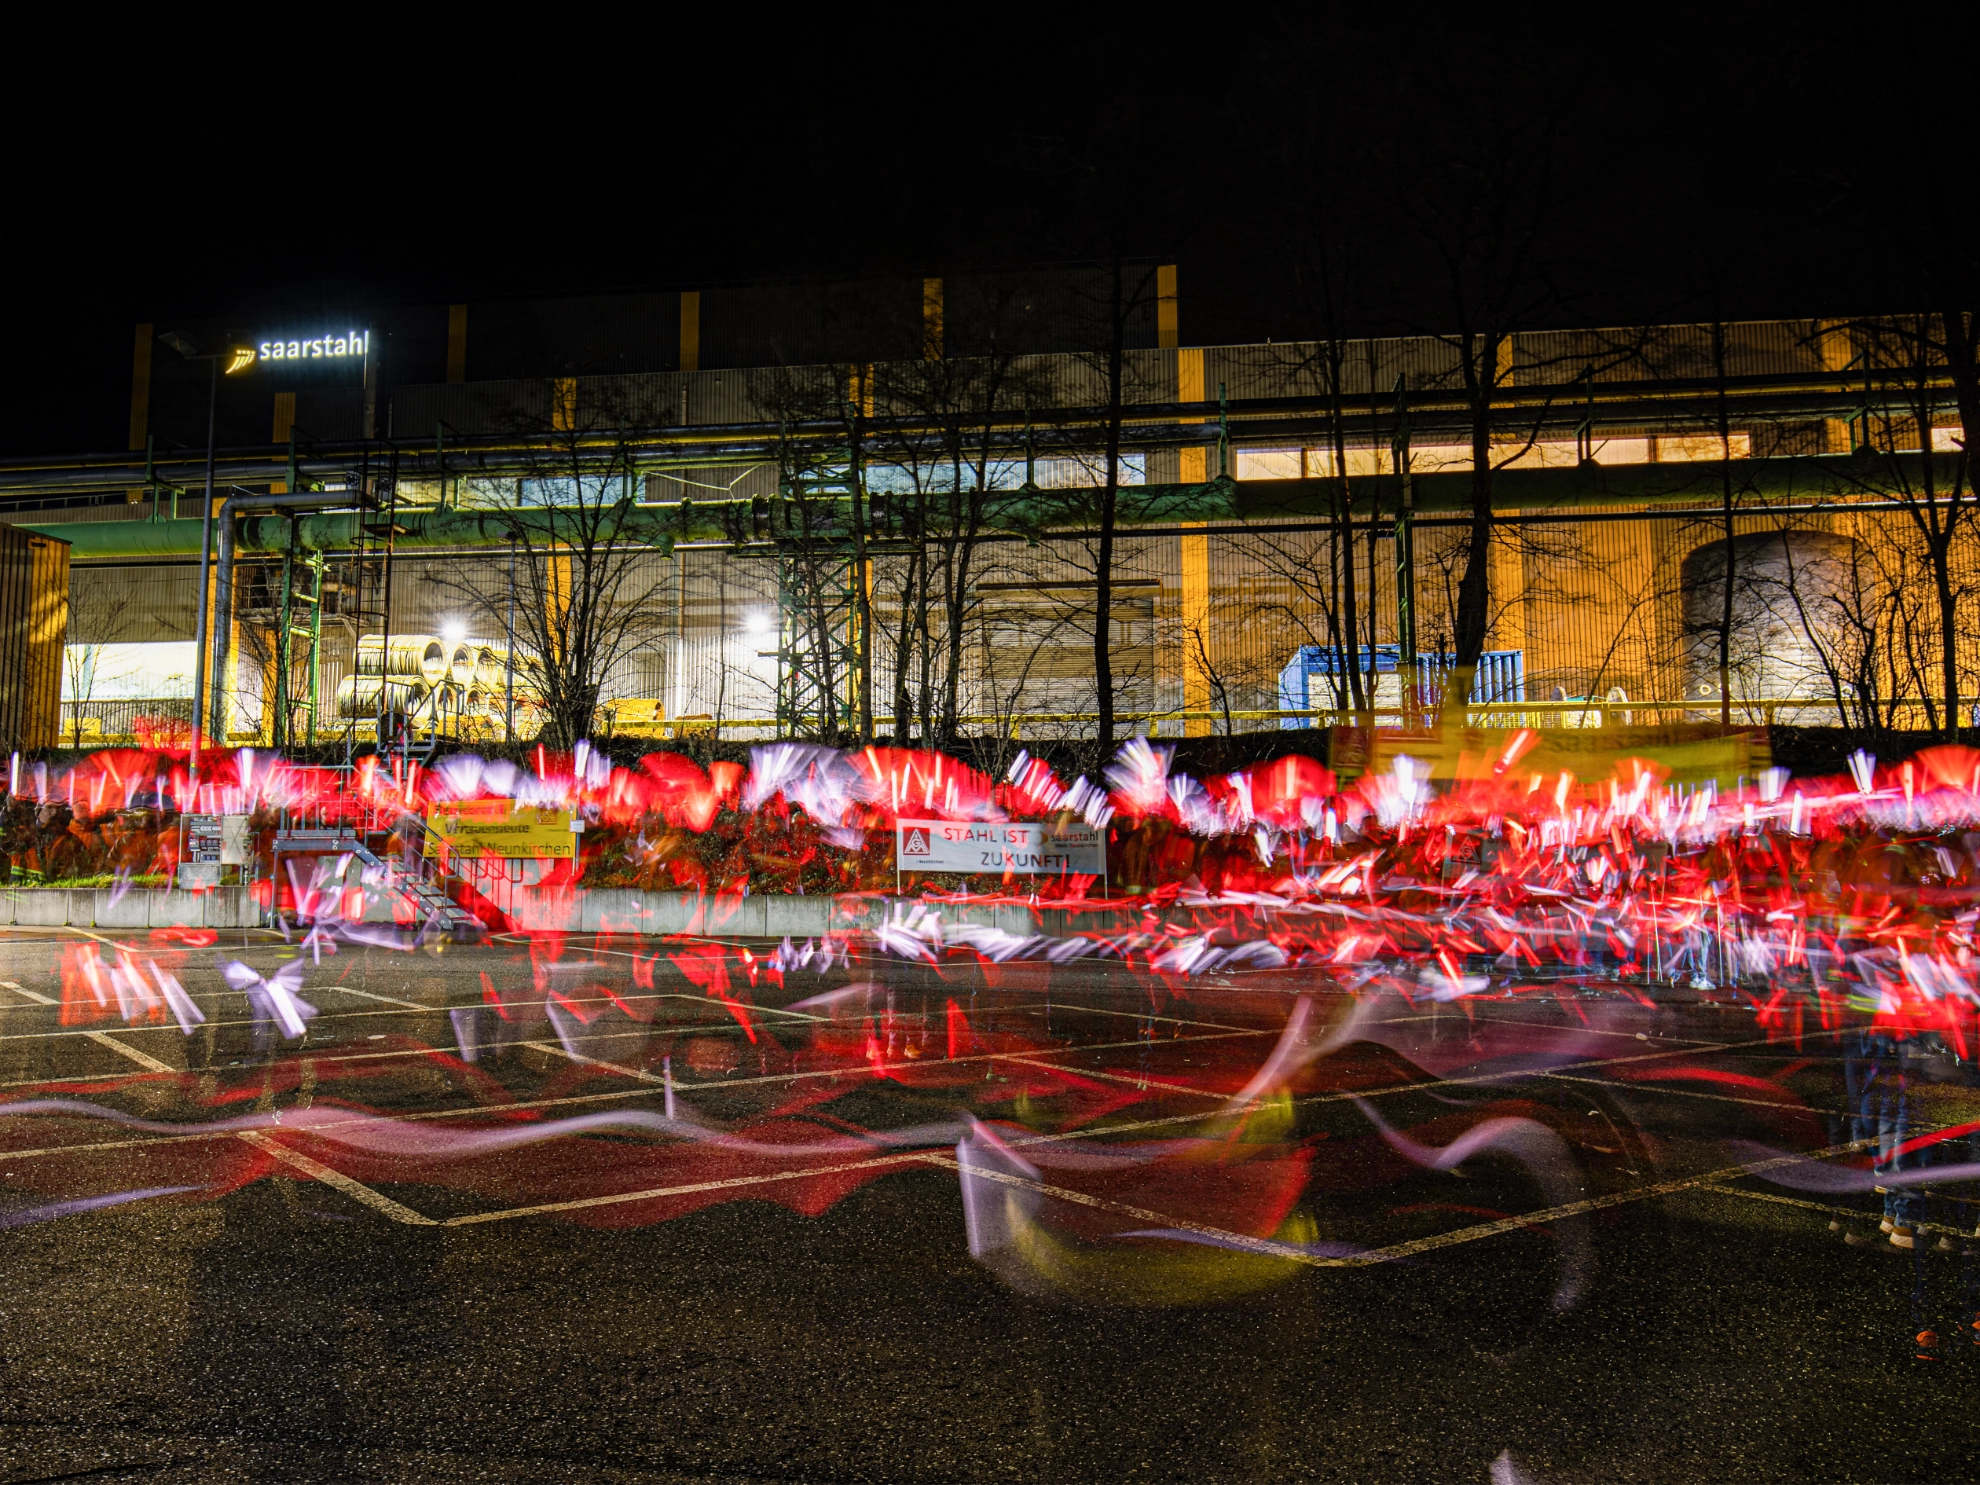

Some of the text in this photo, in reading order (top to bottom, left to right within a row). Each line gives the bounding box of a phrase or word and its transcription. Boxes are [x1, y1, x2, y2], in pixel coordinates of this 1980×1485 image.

[260, 330, 369, 361] saarstahl
[944, 827, 1029, 843] STAHL IST
[487, 842, 570, 855] Neunkirchen
[981, 852, 1070, 868] ZUKUNFT!
